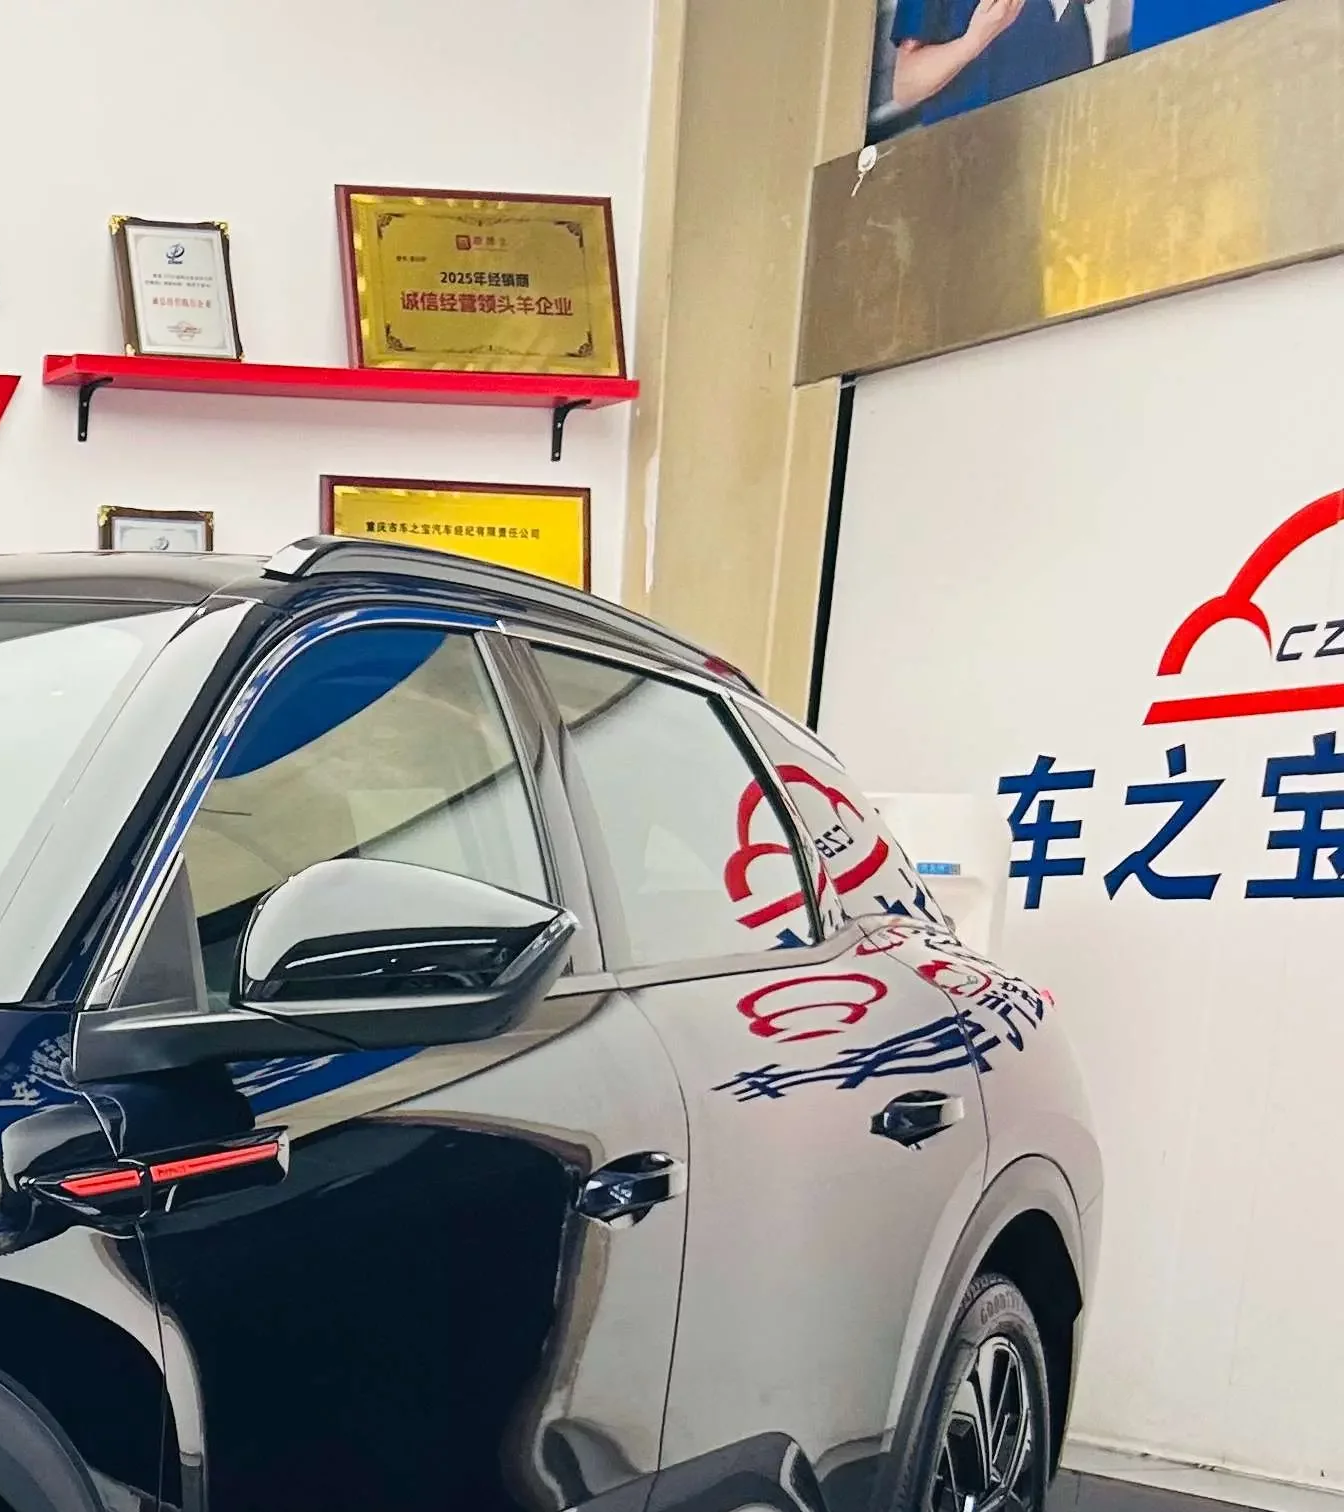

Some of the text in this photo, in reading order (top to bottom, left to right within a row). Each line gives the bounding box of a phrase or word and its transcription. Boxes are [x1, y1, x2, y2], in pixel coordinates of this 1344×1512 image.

[439, 271, 530, 288] 2025年经销商
[400, 290, 574, 317] 诚信经营领头羊企业
[997, 731, 1344, 910] 车之宝
